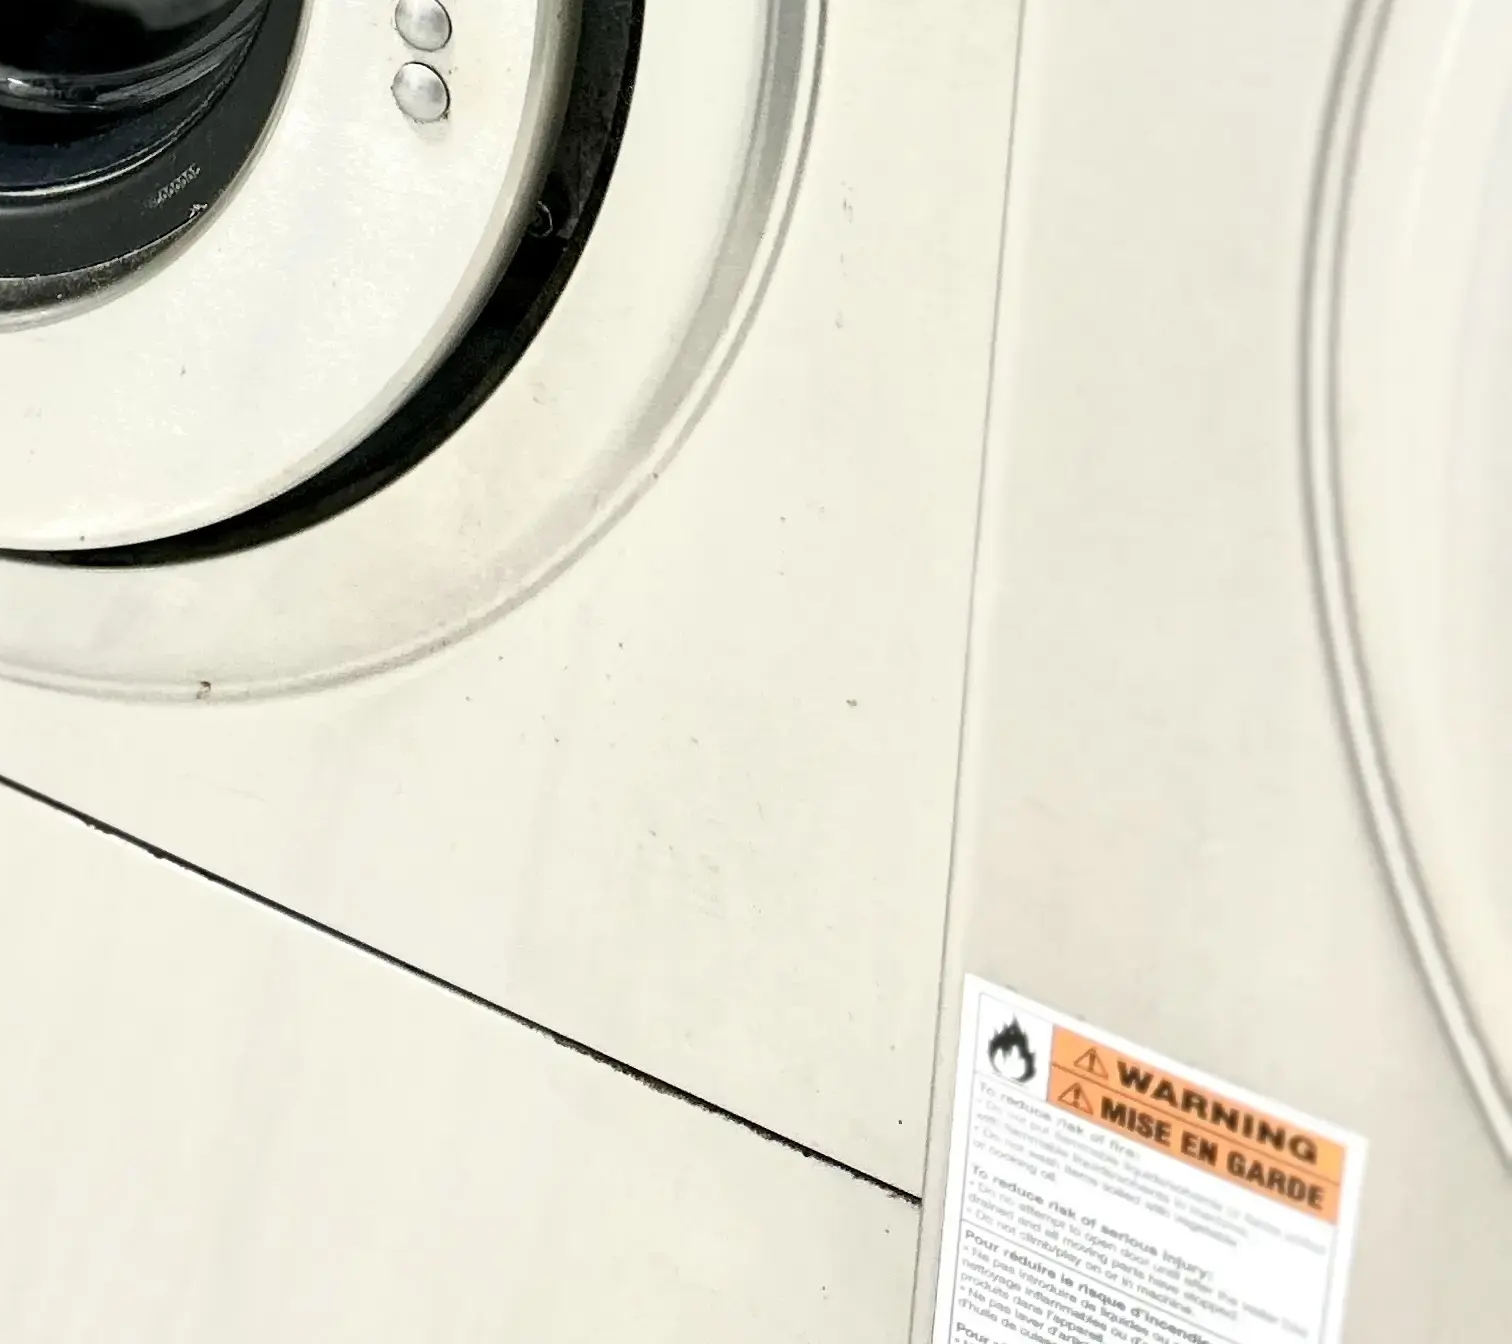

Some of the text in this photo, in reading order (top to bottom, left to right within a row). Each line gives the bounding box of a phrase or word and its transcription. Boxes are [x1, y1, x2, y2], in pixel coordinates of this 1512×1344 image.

[1099, 1095, 1172, 1148] MISE
[1180, 1129, 1218, 1168] EN
[1226, 1149, 1326, 1211] GARDE
[1116, 1060, 1318, 1166] WARNING
